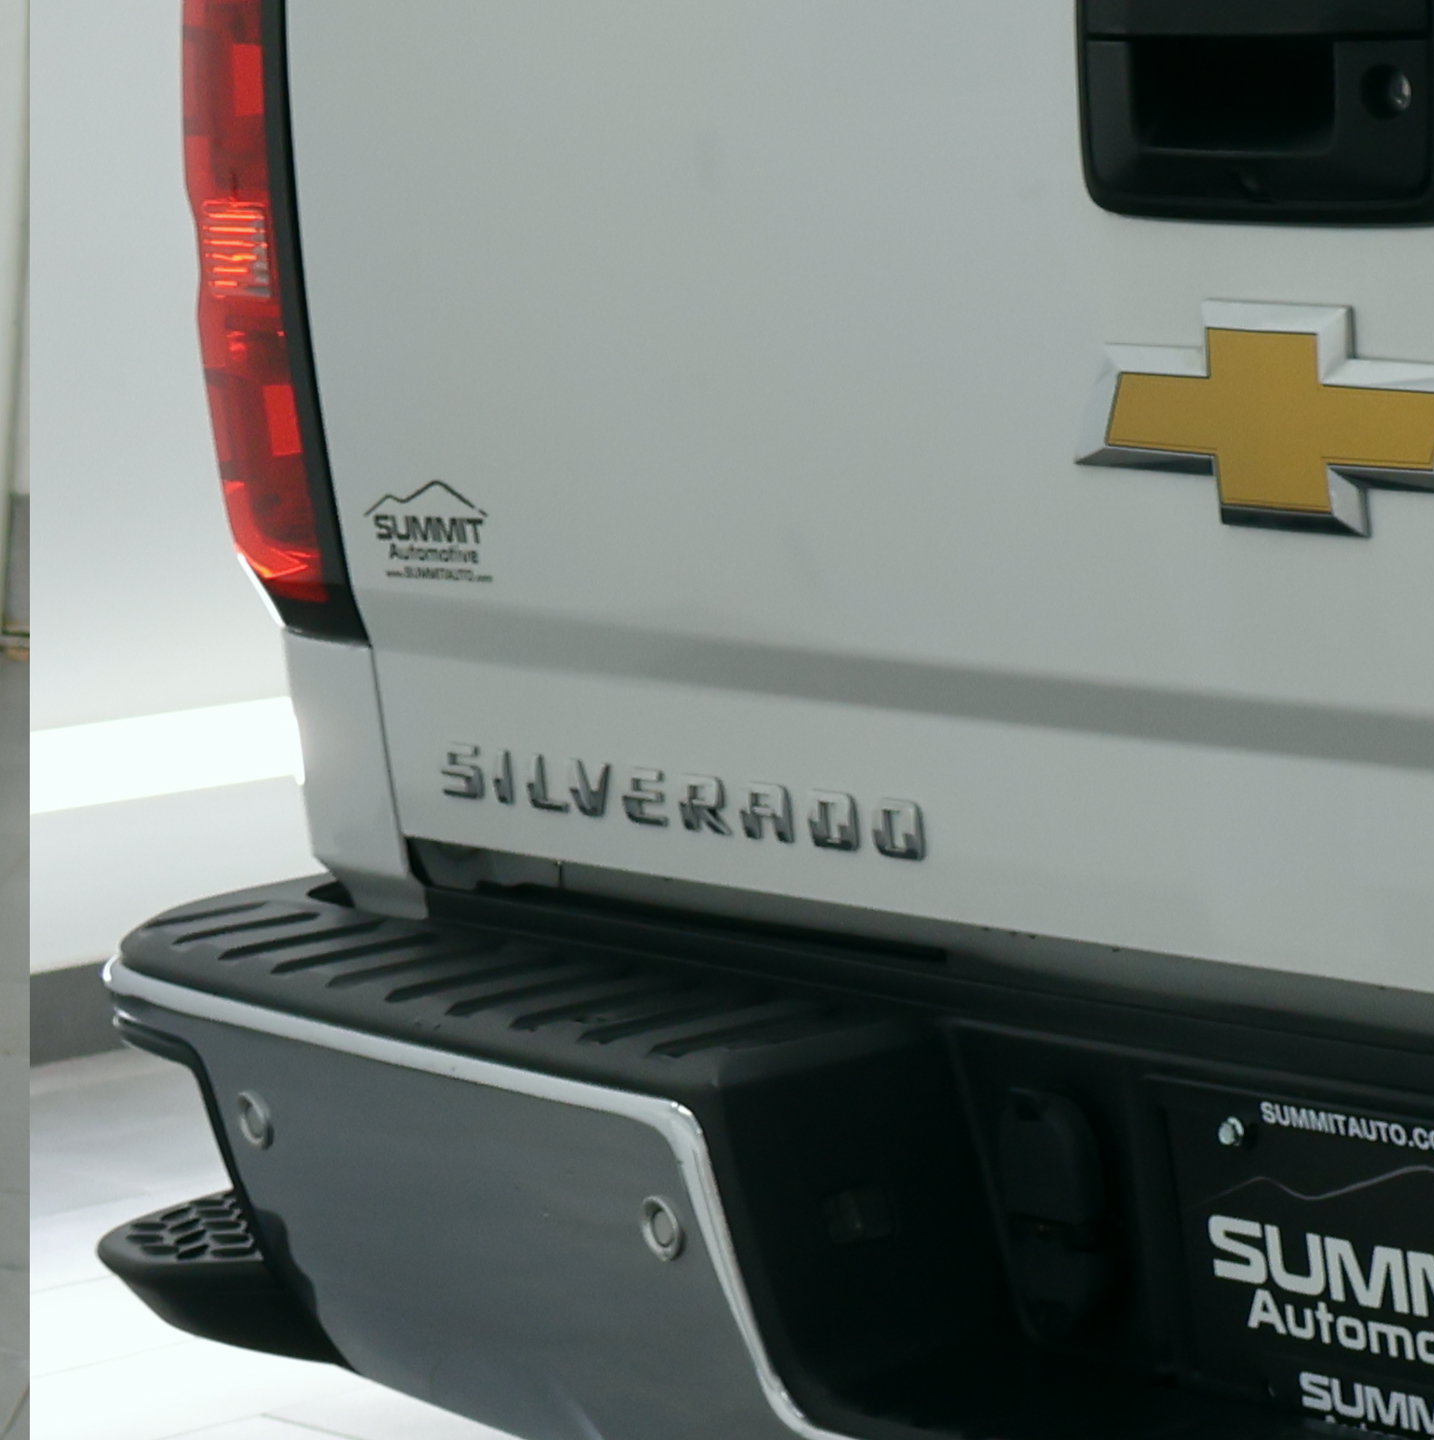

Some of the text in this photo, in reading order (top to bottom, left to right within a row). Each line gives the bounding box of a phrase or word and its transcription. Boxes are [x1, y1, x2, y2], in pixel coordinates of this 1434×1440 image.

[374, 514, 484, 544] SUMMIT
[389, 543, 479, 564] Automotive
[441, 741, 924, 860] SILVERADO
